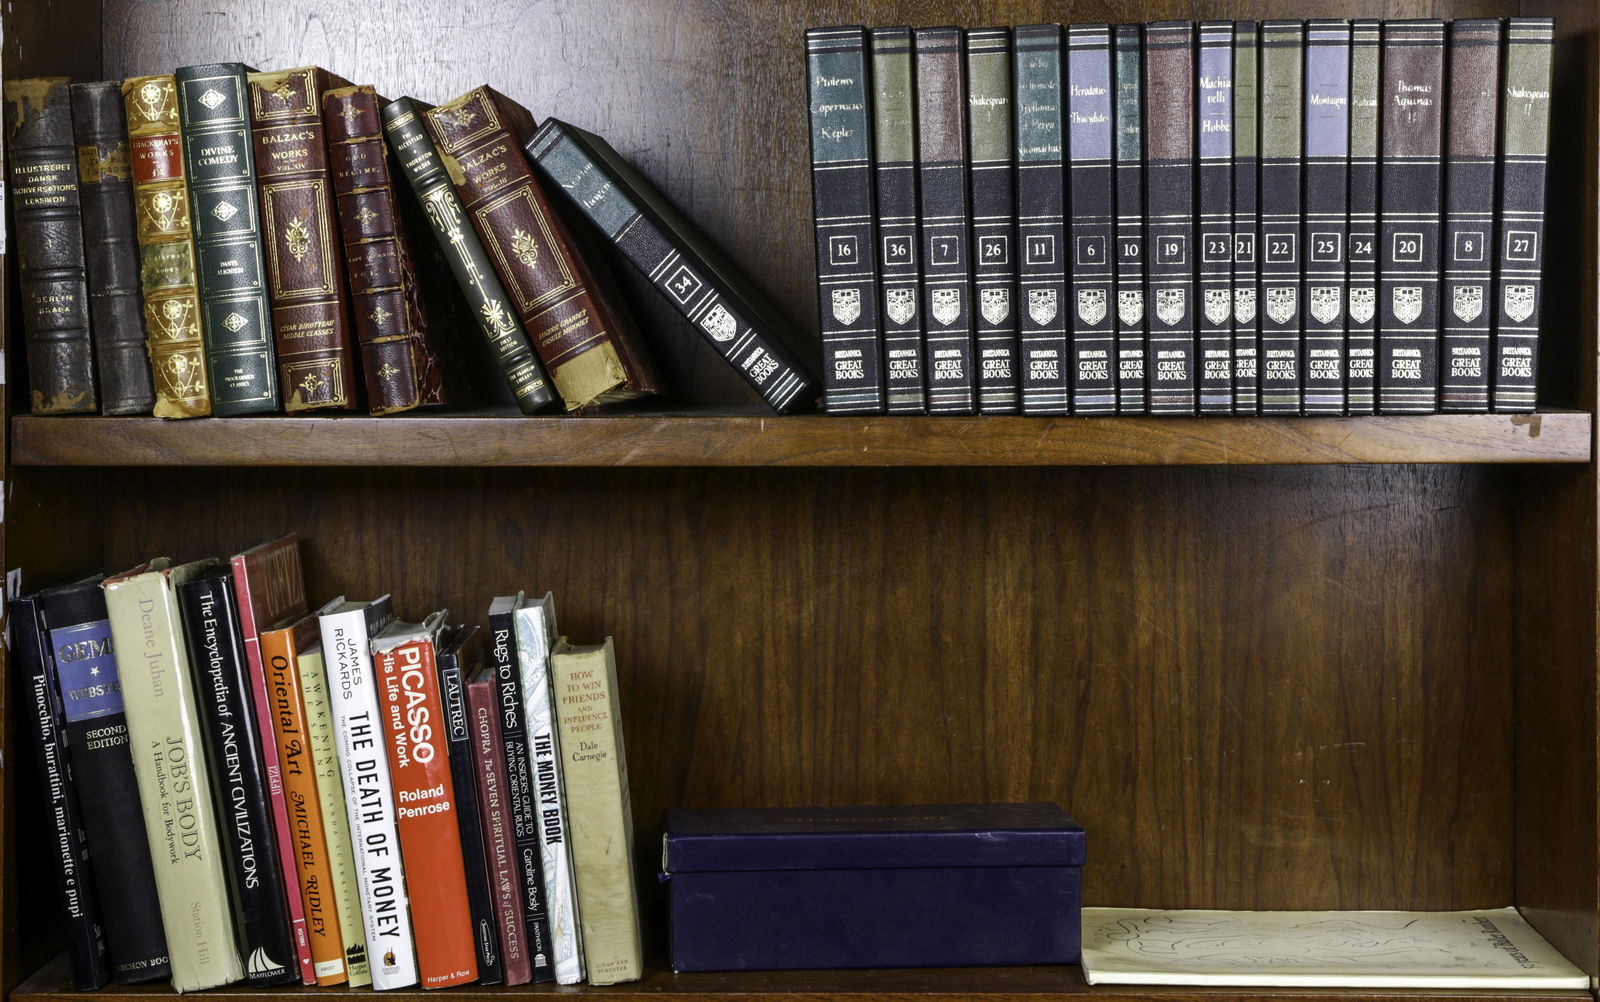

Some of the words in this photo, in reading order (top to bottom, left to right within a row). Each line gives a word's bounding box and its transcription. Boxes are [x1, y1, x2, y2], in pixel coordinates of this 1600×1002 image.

[815, 75, 855, 88] Ptolemy
[1398, 79, 1433, 93] Thomas
[1207, 90, 1225, 104] velli
[1393, 94, 1433, 111] Aquinas
[809, 101, 864, 118] Copernicus
[262, 131, 315, 145] BALZAC'S
[139, 150, 174, 160] WORKS
[198, 155, 239, 166] COMEDY
[201, 145, 236, 157] DIVINE
[271, 148, 308, 160] WORKS
[406, 151, 433, 169] THORNTON
[461, 144, 508, 173] BALZAC'S
[15, 163, 71, 175] ILLUSTRERET
[413, 161, 432, 173] WILDER
[473, 162, 507, 184] WORKS
[28, 174, 58, 183] DANSK
[25, 196, 65, 205] LEKSIKON
[838, 244, 851, 257] 16
[890, 244, 907, 257] 36
[940, 244, 949, 257] 7
[985, 244, 1002, 257] 26
[1034, 243, 1046, 256] 11
[1087, 244, 1096, 257] 6
[1123, 244, 1139, 257] 10
[1164, 243, 1178, 256] 19
[1209, 241, 1226, 254] 23
[1237, 241, 1252, 254] 21
[1272, 242, 1289, 255] 22
[1317, 241, 1335, 254] 25
[1355, 241, 1372, 254] 24
[1399, 240, 1417, 254] 20
[1464, 240, 1473, 252] 8
[1513, 239, 1530, 252] 27
[220, 260, 239, 268] DANTE
[674, 275, 692, 295] 34
[36, 295, 73, 304] BERLIN
[298, 319, 335, 332] BIROTTEAU
[560, 309, 587, 328] GRANDET
[562, 316, 590, 336] MIROUET
[282, 331, 305, 340] MIDDLE
[306, 328, 335, 338] CLASSES
[749, 352, 773, 378] GREAT
[835, 359, 863, 370] GREAT
[1079, 360, 1108, 371] GREAT
[1501, 367, 1532, 377] BOOKS
[1502, 357, 1532, 368] GREAT
[754, 360, 780, 386] BOOKS
[835, 369, 865, 380] BOOKS
[1079, 370, 1109, 380] BOOKS
[199, 590, 215, 617] The
[139, 598, 158, 648] Deane
[58, 636, 113, 664] GEM
[493, 628, 509, 663] Rugs
[203, 617, 231, 703] Encyclopedia
[334, 628, 353, 700] RICKARDS
[347, 638, 363, 686] JAMES
[382, 652, 396, 674] His
[143, 651, 167, 699] Juhan
[500, 664, 512, 680] to
[570, 669, 594, 681] HOW
[271, 655, 299, 734] Oriental
[386, 676, 399, 702] Life
[567, 684, 580, 693] TO
[582, 680, 602, 691] WIN
[33, 673, 52, 741] Pinocchio,
[398, 646, 435, 764] PICASSO
[446, 673, 465, 736] LAUTREC
[501, 681, 519, 729] Riches
[562, 691, 606, 705] FRIENDS
[217, 701, 233, 718] of
[390, 705, 405, 731] and
[563, 711, 609, 725] INFLUENCE
[577, 705, 593, 713] AND
[86, 724, 127, 740] SECOND
[310, 671, 336, 778] AWAKENING
[349, 710, 374, 751] THE
[478, 707, 492, 754] CHOPRA
[570, 723, 603, 734] PEOPLE
[87, 734, 129, 751] EDITION
[151, 740, 161, 749] A
[342, 731, 352, 757] COMING
[395, 731, 411, 769] Work
[515, 742, 524, 756] AN
[534, 733, 552, 758] THE
[580, 741, 598, 752] Dale
[220, 721, 244, 785] ANCIENT
[284, 740, 305, 776] Art
[505, 741, 517, 772] BUYING
[572, 751, 607, 763] Carnegie
[43, 741, 65, 805] burattini,
[166, 736, 191, 794] JOB'S
[153, 751, 168, 799] Handbook
[267, 765, 282, 796] UFFIZI
[346, 759, 357, 795] COLLAPSE
[536, 760, 558, 804] MONEY
[355, 759, 384, 824] DEATH
[399, 783, 445, 803] Roland
[486, 772, 500, 808] SEVEN
[509, 773, 523, 815] ORIENTAL
[161, 801, 173, 816] for
[398, 801, 451, 819] Penrose
[521, 795, 533, 822] GUIDE
[176, 796, 202, 862] BODY
[289, 789, 317, 869] MICHAEL
[514, 815, 525, 838] RUGS
[526, 822, 534, 835] TO
[542, 808, 563, 846] BOOK
[54, 805, 75, 876] marionette
[164, 818, 180, 865] Bodywork
[231, 786, 260, 889] CIVILIZATIONS
[366, 833, 389, 857] OF
[491, 809, 508, 868] SPIRITUAL
[356, 823, 367, 874] INTERNATIONAL
[522, 848, 536, 886] Caroline
[66, 877, 76, 886] e
[499, 869, 512, 900] LAWS
[65, 888, 84, 919] pupi
[364, 877, 373, 913] MONETARY
[370, 866, 400, 938] MONEY
[526, 885, 540, 912] Bosly
[305, 874, 327, 938] RIDLEY
[190, 902, 205, 943] Station
[368, 915, 376, 942] SYSTEM
[504, 909, 520, 960] SUCCESS
[533, 922, 543, 952] PANTHEON
[197, 940, 212, 965] Hill
[249, 968, 287, 980] MAYFLOWER
[348, 963, 368, 972] Harper
[349, 968, 368, 977] Collins
[427, 974, 449, 983] Harper
[457, 970, 471, 978] Row
